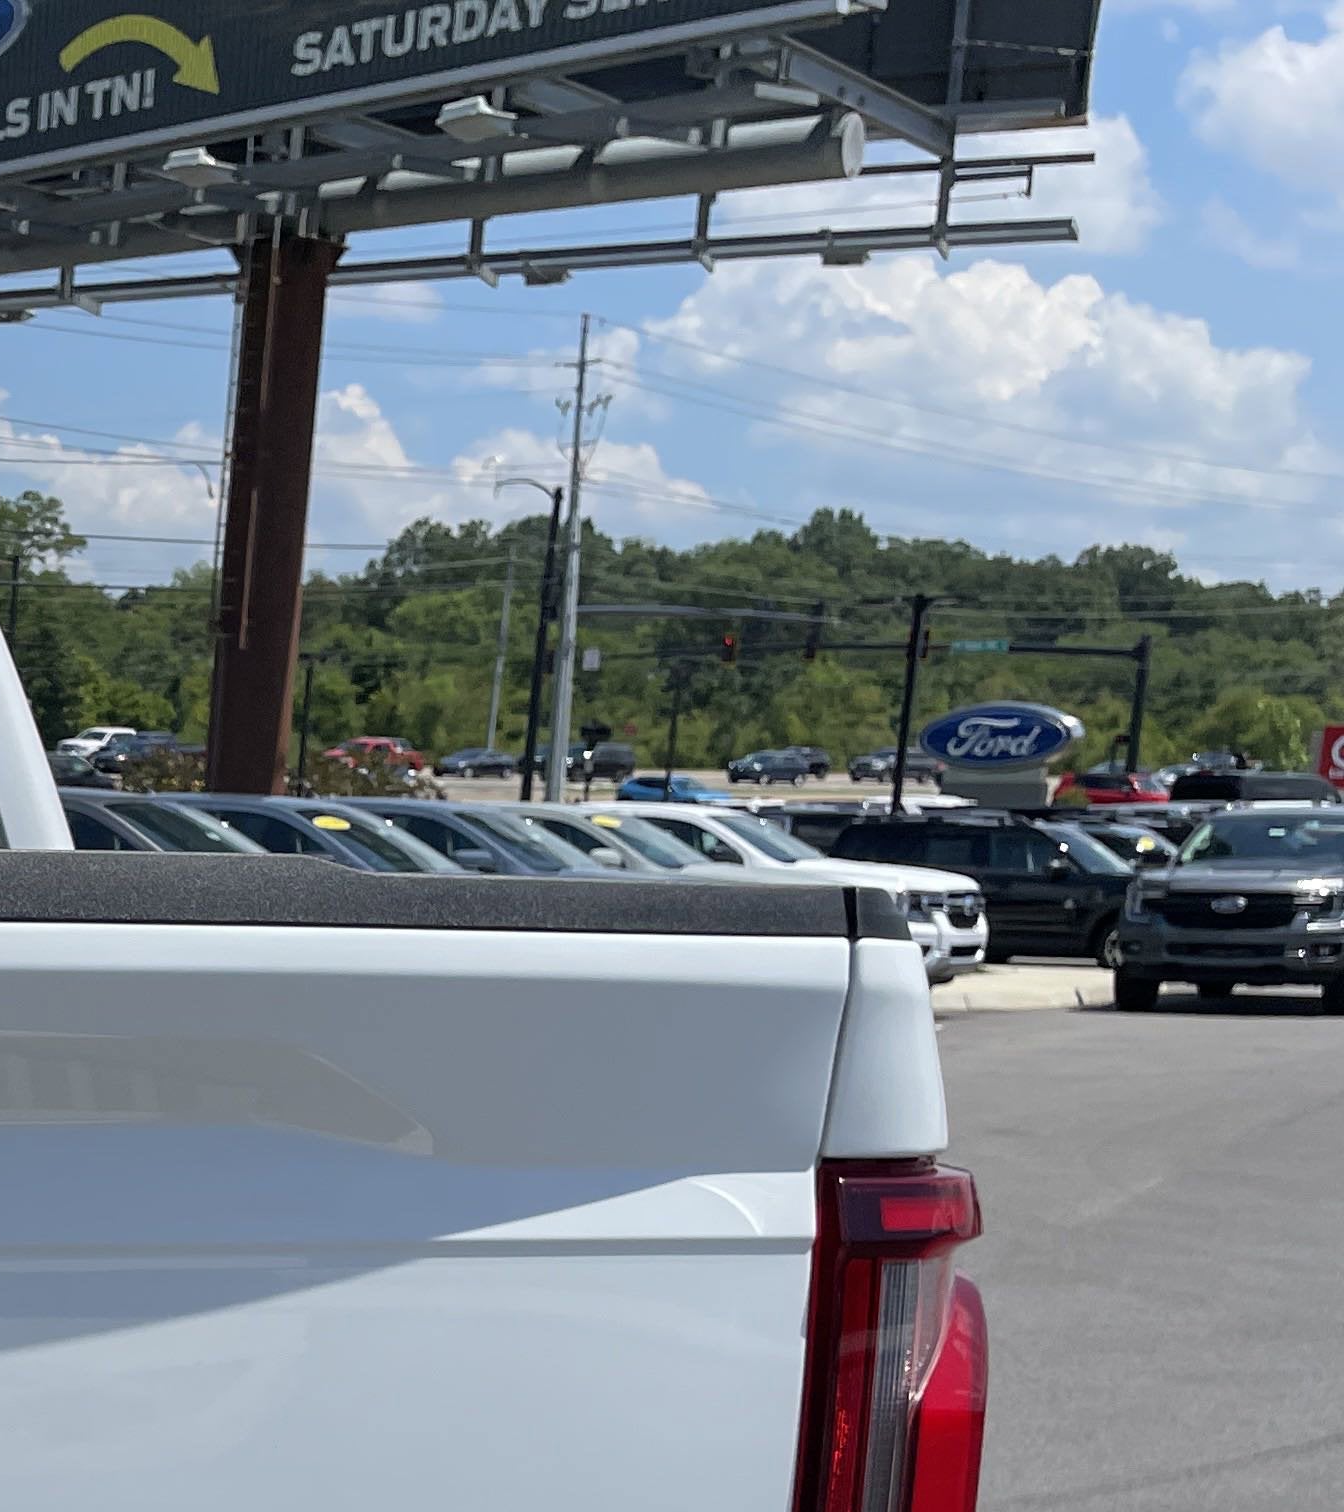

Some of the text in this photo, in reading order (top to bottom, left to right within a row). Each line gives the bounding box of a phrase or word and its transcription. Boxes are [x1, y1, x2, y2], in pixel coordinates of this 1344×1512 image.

[291, 0, 547, 77] SATURDAY
[37, 85, 80, 131] IN
[85, 68, 157, 120] TN!
[946, 717, 1042, 757] Ford
